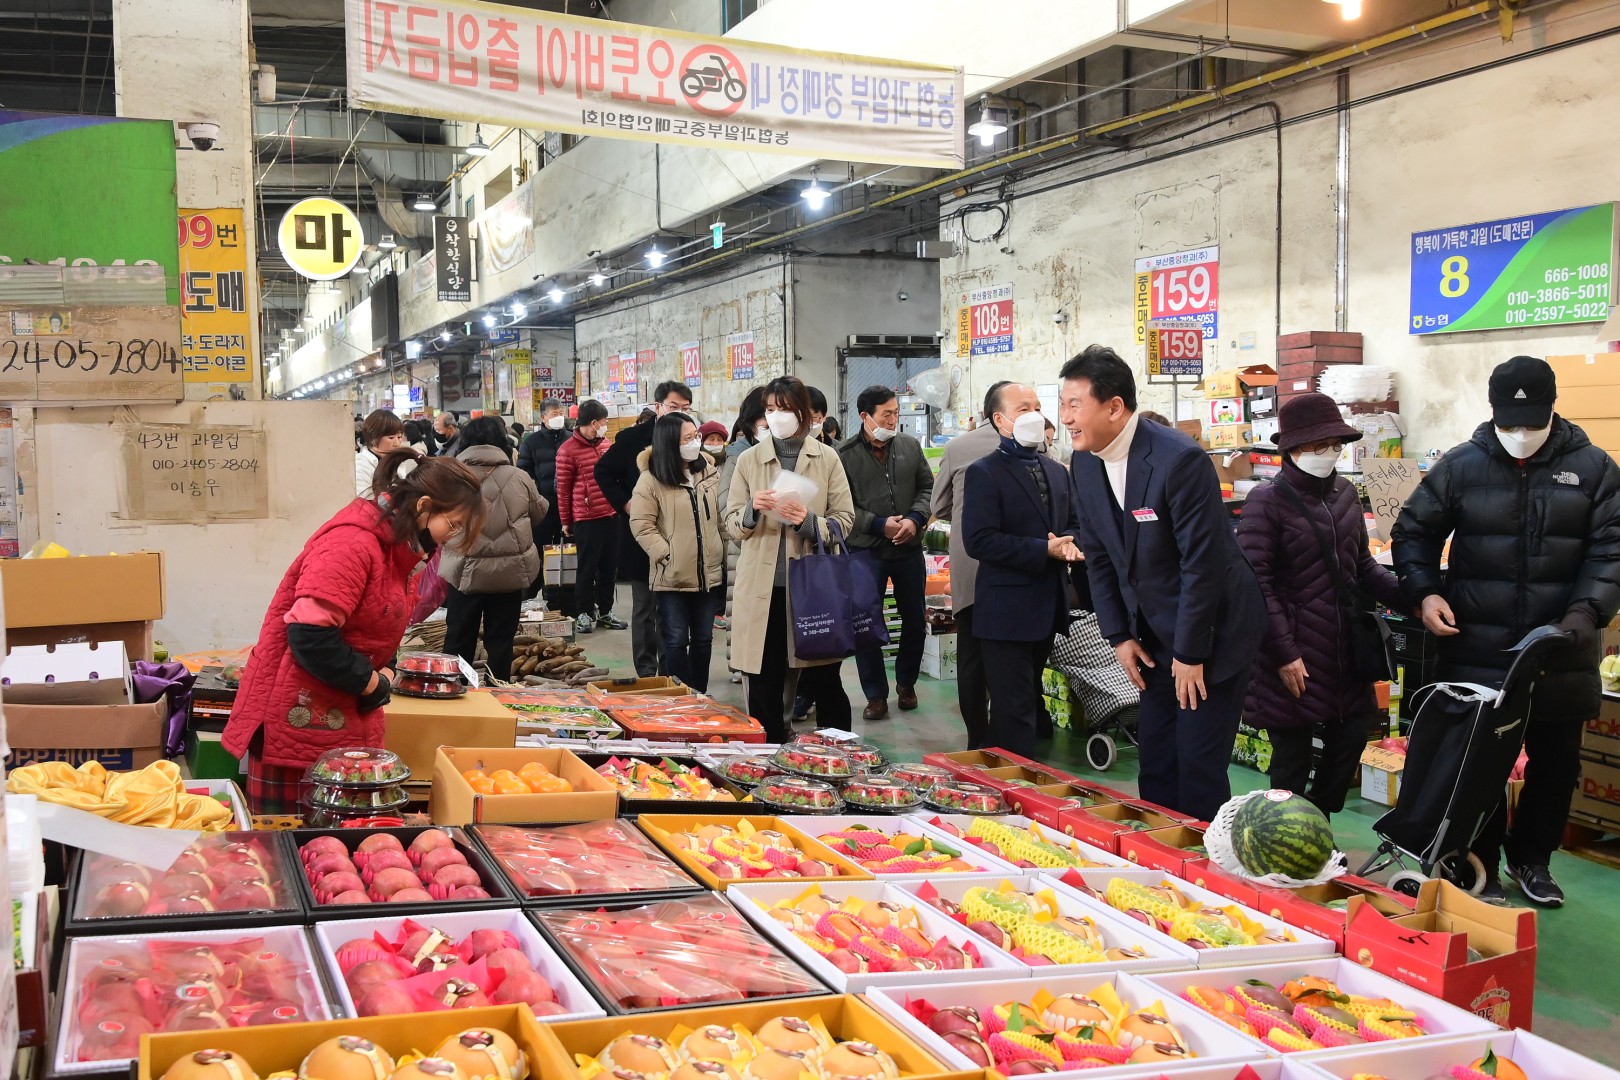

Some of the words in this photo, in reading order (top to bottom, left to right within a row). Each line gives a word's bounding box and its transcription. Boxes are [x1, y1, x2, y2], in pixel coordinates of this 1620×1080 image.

[294, 213, 352, 263] 마
[1415, 236, 1440, 254] 행복이
[1442, 230, 1468, 249] 가득한
[1470, 227, 1488, 246] 과일
[1490, 220, 1534, 244] (도매전문)
[445, 233, 463, 290] 착한식당
[1439, 255, 1470, 298] 8
[1545, 263, 1608, 284] 666-1008
[185, 271, 245, 312] 도매
[1507, 283, 1608, 306] 010-3866-5011
[1425, 313, 1449, 327] 농협
[1505, 302, 1608, 324] 010-2597-5022
[137, 432, 180, 451] 43번
[191, 432, 241, 451] 과일집
[152, 458, 261, 474] 010-2405-2804
[1583, 777, 1620, 801] Dole
